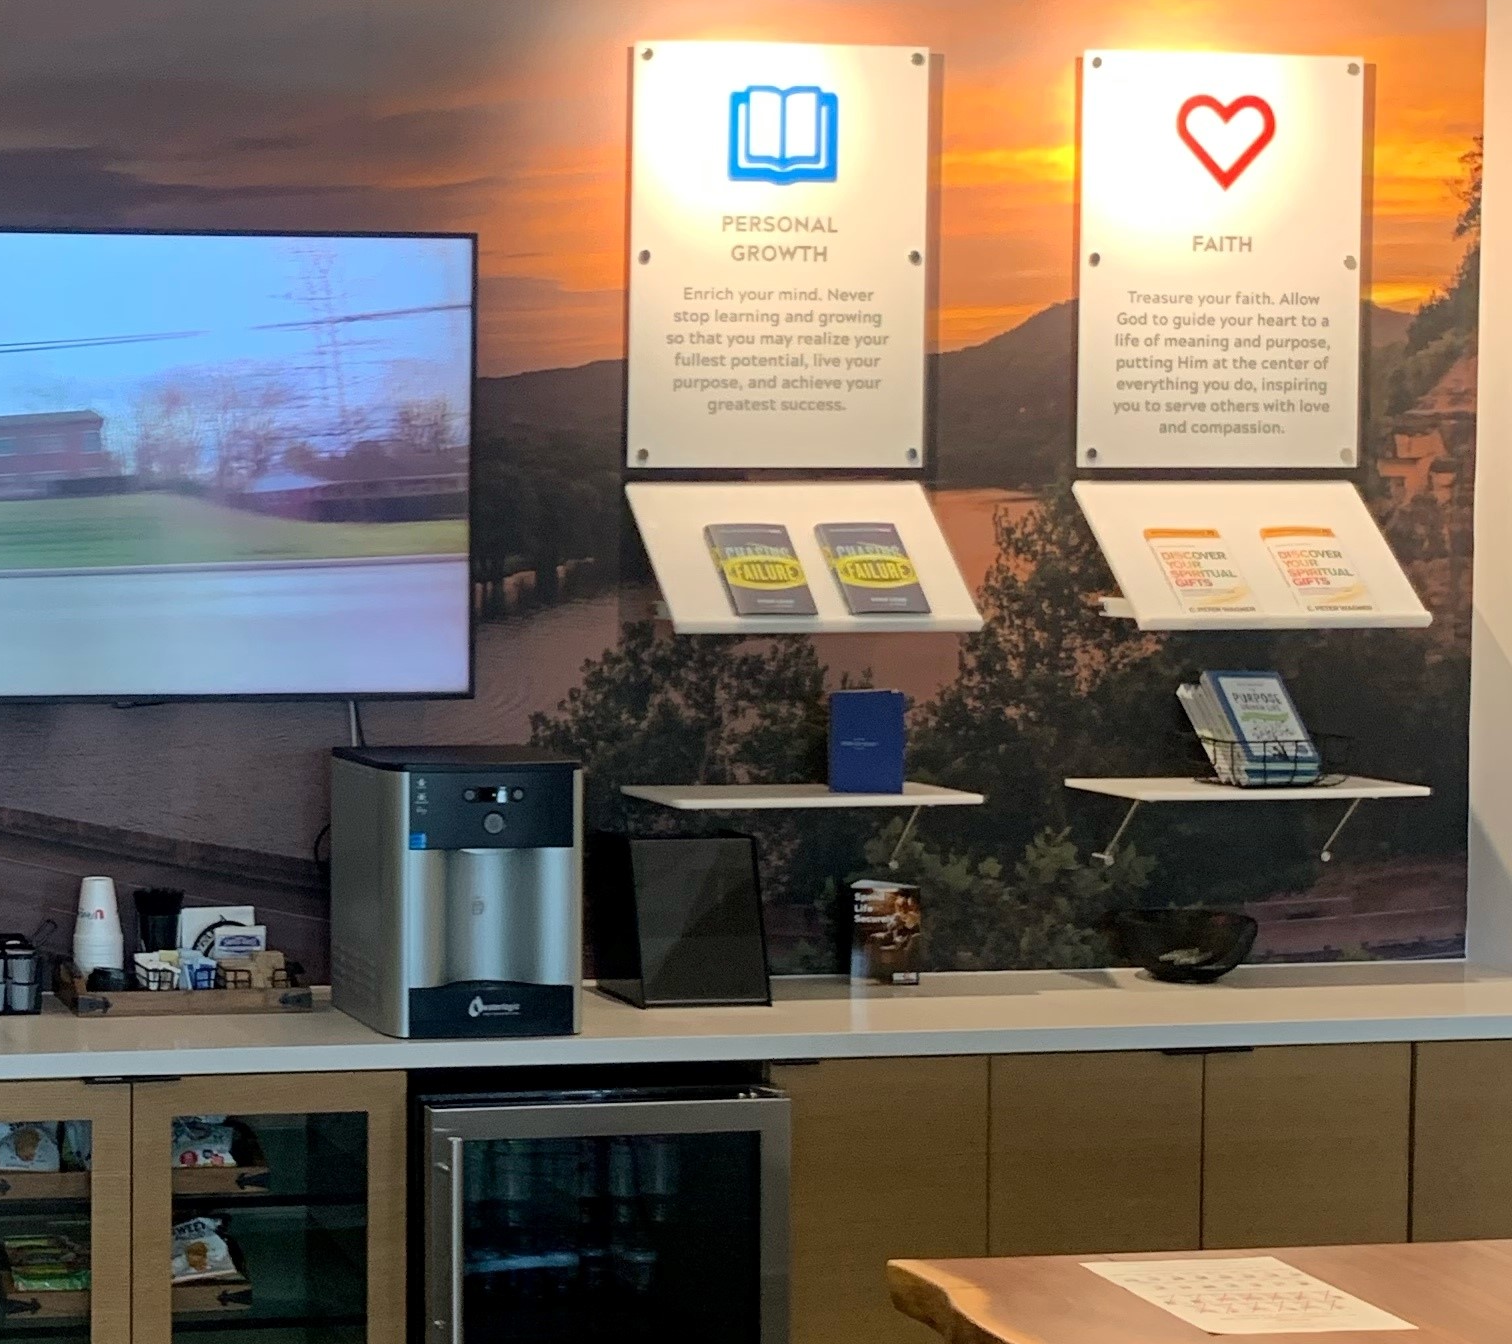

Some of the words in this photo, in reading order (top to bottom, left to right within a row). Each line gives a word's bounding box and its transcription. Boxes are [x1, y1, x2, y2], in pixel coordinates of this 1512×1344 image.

[722, 216, 838, 232] PERSONAL
[1193, 236, 1252, 251] FAITH
[731, 245, 827, 261] GROWTH
[684, 287, 734, 301] Enrich
[738, 291, 774, 304] your
[779, 288, 822, 301] mind.
[828, 288, 874, 302] Never
[1127, 291, 1193, 304] Treasure
[1198, 295, 1231, 307] your
[1235, 291, 1275, 305] faith.
[1279, 292, 1320, 305] Allow
[674, 311, 710, 326] stop
[715, 310, 780, 327] learning
[784, 310, 814, 323] and
[818, 310, 882, 328] growing
[1117, 312, 1147, 325] God
[1152, 314, 1168, 326] to
[1172, 313, 1216, 330] guide
[1220, 316, 1253, 329] your
[1257, 313, 1297, 327] heart
[1301, 316, 1317, 328] to
[1321, 317, 1329, 327] a
[666, 334, 685, 345] so
[689, 331, 722, 345] that
[726, 335, 755, 349] you
[760, 335, 793, 348] may
[797, 332, 850, 345] realize
[854, 336, 889, 349] your
[1115, 333, 1140, 347] life
[1144, 333, 1160, 347] of
[1164, 334, 1229, 352] meaning
[1234, 334, 1261, 348] and
[1266, 338, 1330, 352] purpose,
[674, 352, 727, 367] fullest
[730, 353, 809, 370] potential,
[813, 353, 841, 367] live
[845, 357, 881, 370] your
[1116, 355, 1173, 373] putting
[1178, 356, 1208, 369] Him
[1212, 358, 1228, 369] at
[1232, 356, 1257, 370] the
[1261, 357, 1310, 370] center
[1313, 356, 1329, 370] of
[673, 378, 743, 392] purpose,
[747, 375, 778, 389] and
[781, 375, 843, 389] achieve
[846, 379, 882, 392] your
[1116, 376, 1199, 394] everything
[1202, 380, 1230, 394] you
[1234, 378, 1257, 393] do,
[1262, 377, 1327, 395] inspiring
[707, 399, 777, 415] greatest
[780, 400, 847, 412] success.
[1113, 402, 1140, 415] you
[1145, 400, 1161, 412] to
[1165, 402, 1206, 412] serve
[1210, 398, 1260, 413] others
[1263, 399, 1295, 412] with
[1299, 399, 1330, 413] love
[1159, 420, 1188, 434] and
[1191, 420, 1285, 437] compassion.
[1161, 552, 1226, 560] DISCOVER
[1277, 550, 1342, 559] DISCOVER
[1283, 559, 1318, 567] YOUR
[735, 562, 796, 580] FAILURE
[846, 562, 907, 579] FAILURE
[1170, 569, 1237, 578] SPIRITUAL
[1287, 568, 1354, 577] SPIRITUAL
[1175, 578, 1213, 587] GIFTS
[1292, 577, 1331, 586] GIFTS
